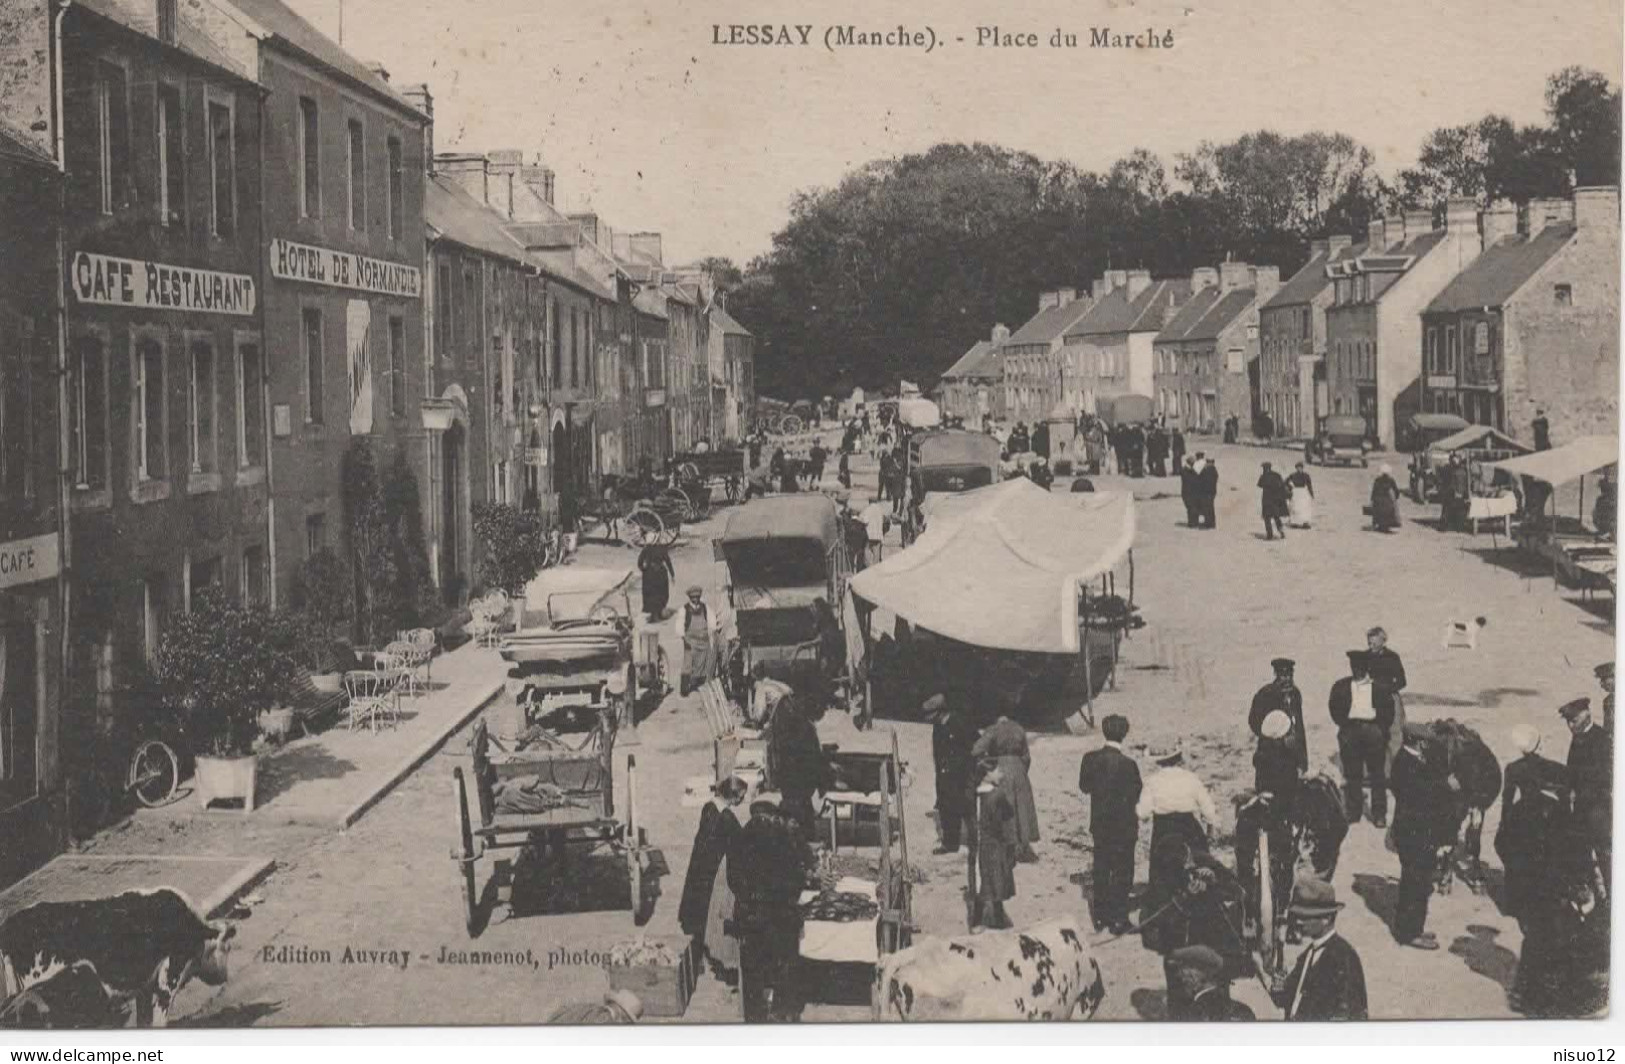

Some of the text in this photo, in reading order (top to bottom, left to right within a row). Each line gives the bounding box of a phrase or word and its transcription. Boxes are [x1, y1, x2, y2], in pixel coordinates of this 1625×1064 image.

[77, 253, 252, 313] CAFE RESTAURANT
[277, 240, 417, 294] HOTEL DE NORMANDIE
